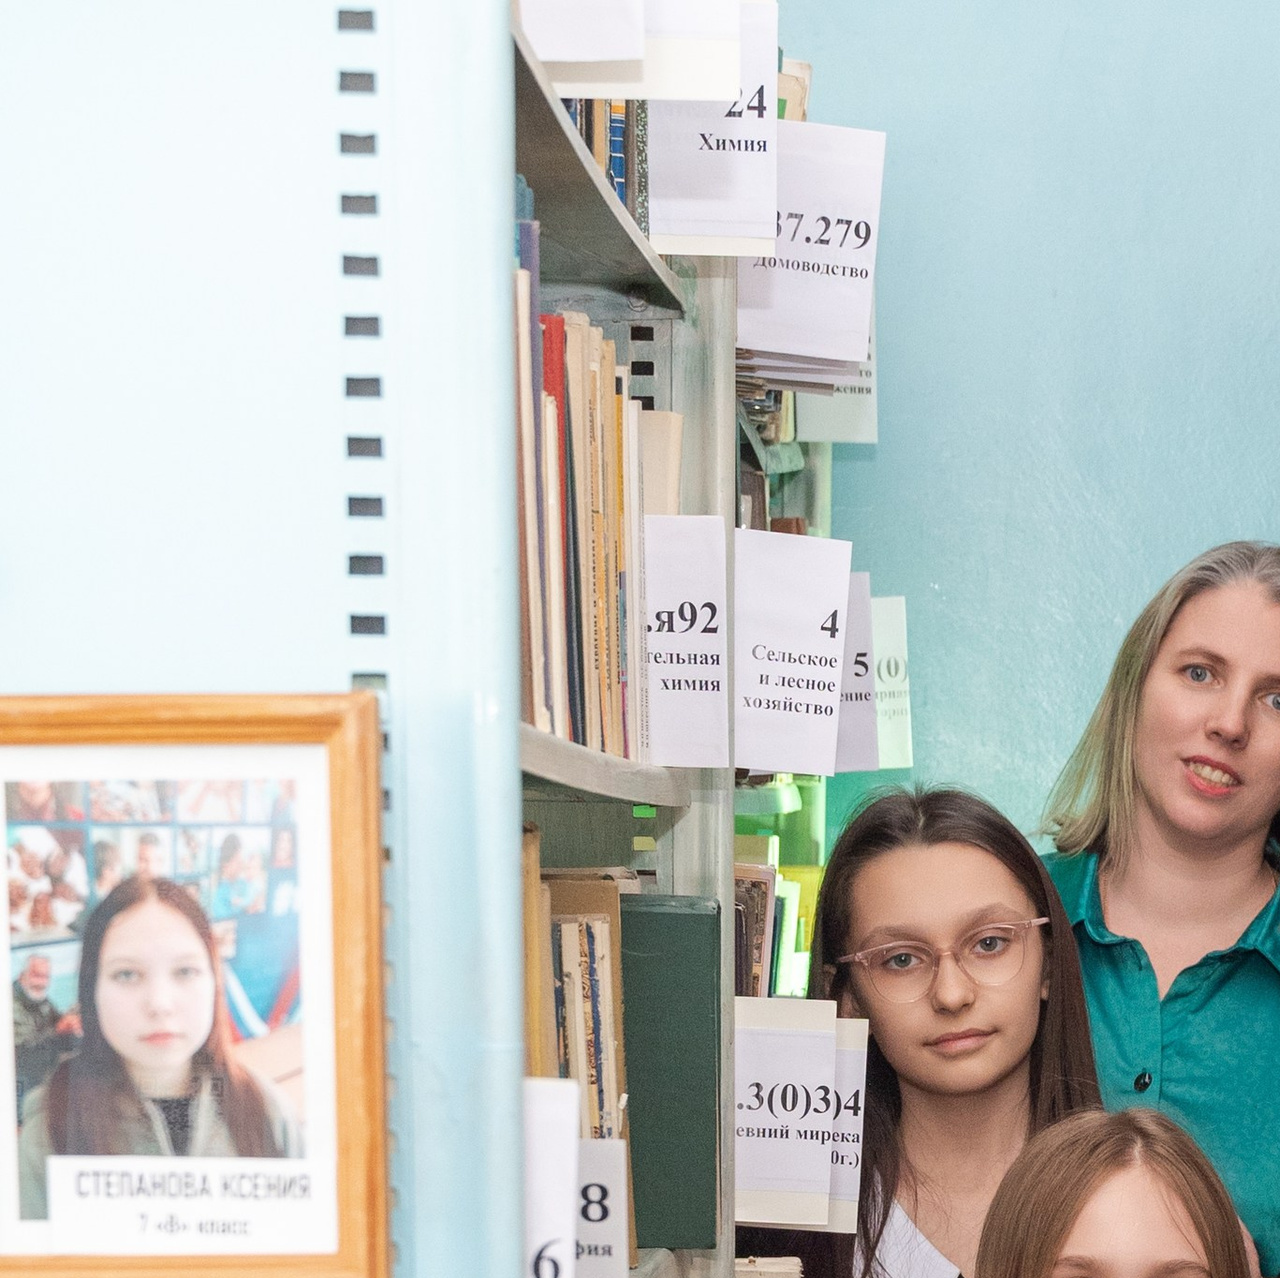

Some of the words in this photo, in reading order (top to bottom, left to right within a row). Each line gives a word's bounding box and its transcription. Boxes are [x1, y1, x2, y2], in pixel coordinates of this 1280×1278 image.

[699, 133, 768, 153] Химия
[753, 255, 869, 280] Домоводство
[820, 609, 839, 639] 4
[752, 644, 838, 669] Сельское
[853, 652, 869, 677] 5
[661, 677, 721, 692] химия
[759, 673, 770, 685] и
[774, 676, 836, 693] лесное
[743, 693, 834, 717] хозяйство
[75, 1170, 213, 1198] СТЕПАНОВА
[221, 1173, 312, 1200] КСЕНИЯ
[581, 1183, 609, 1223] 8
